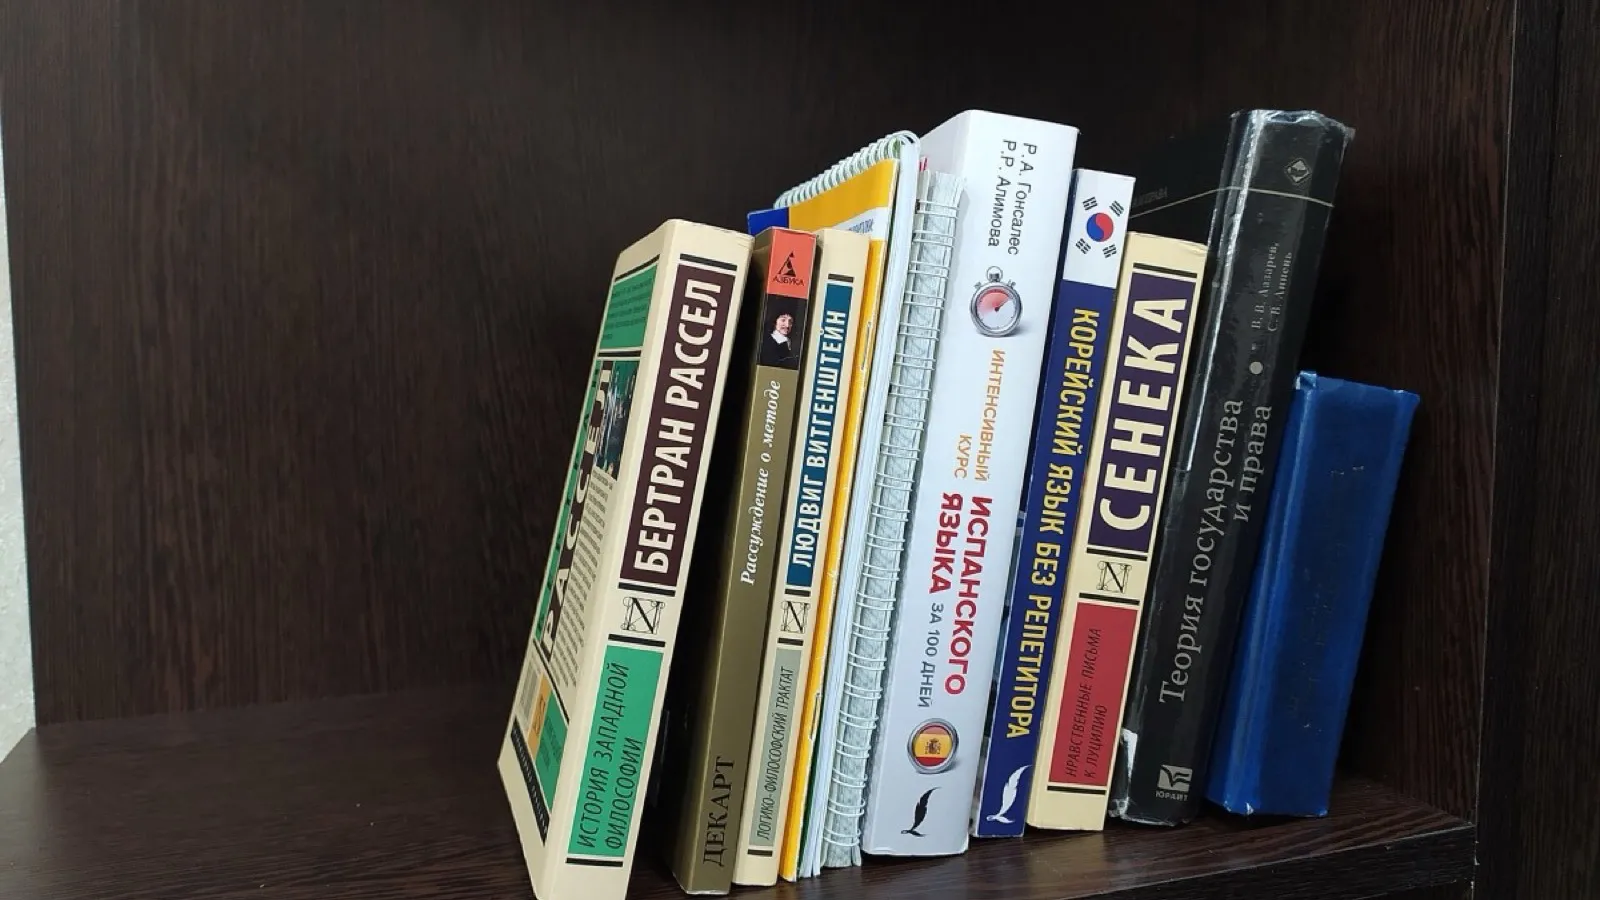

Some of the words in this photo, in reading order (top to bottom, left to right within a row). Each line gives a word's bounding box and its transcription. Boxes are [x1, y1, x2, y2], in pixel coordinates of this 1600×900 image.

[988, 176, 1011, 247] Алимова
[1007, 182, 1032, 255] Гонсалес
[634, 417, 696, 575] БЕРТРАН
[665, 278, 722, 410] РАССЕЛ
[763, 380, 781, 448] методе
[806, 310, 847, 468] ВИТГЕНШТЕЙН
[975, 350, 1006, 481] ИНТЕНСИВНЫЙ
[1052, 308, 1100, 456] КОРЕЙСКИЙ
[1099, 299, 1187, 531] СЕНЕКА
[761, 452, 772, 463] о
[954, 434, 972, 479] КУРС
[1240, 405, 1272, 495] права
[740, 468, 769, 586] Рассуждение
[792, 475, 823, 568] ЛЮДВИГ
[929, 492, 964, 594] ЯЗЫКА
[1039, 463, 1073, 535] ЯЗЫК
[1234, 503, 1251, 523] и
[944, 496, 993, 695] ИСПАНСКОГО
[1031, 543, 1060, 586] БЕЗ
[1159, 595, 1204, 703] Теория
[1190, 399, 1244, 587] государства
[925, 630, 941, 656] 100
[929, 602, 944, 624] ЗА
[918, 662, 936, 708] ДНЕЙ
[1006, 594, 1052, 738] РЕПЕТИТОРА
[1066, 683, 1093, 777] НРАВСТВЕННЫЕ
[1081, 628, 1102, 679] ПИСЬМА
[577, 767, 610, 849] ИСТОРИЯ
[595, 661, 630, 761] ЗАПАДНОЙ
[757, 711, 788, 840] ЛОГИКО-ФИЛОСОФСКИЙ
[776, 667, 794, 710] ТРАКТАТ
[1084, 770, 1096, 779] К
[1086, 705, 1108, 767] ЛУЦИЛИЮ
[604, 736, 643, 850] ФИЛОСОФИИ
[703, 755, 734, 867] ДЕКАРТ
